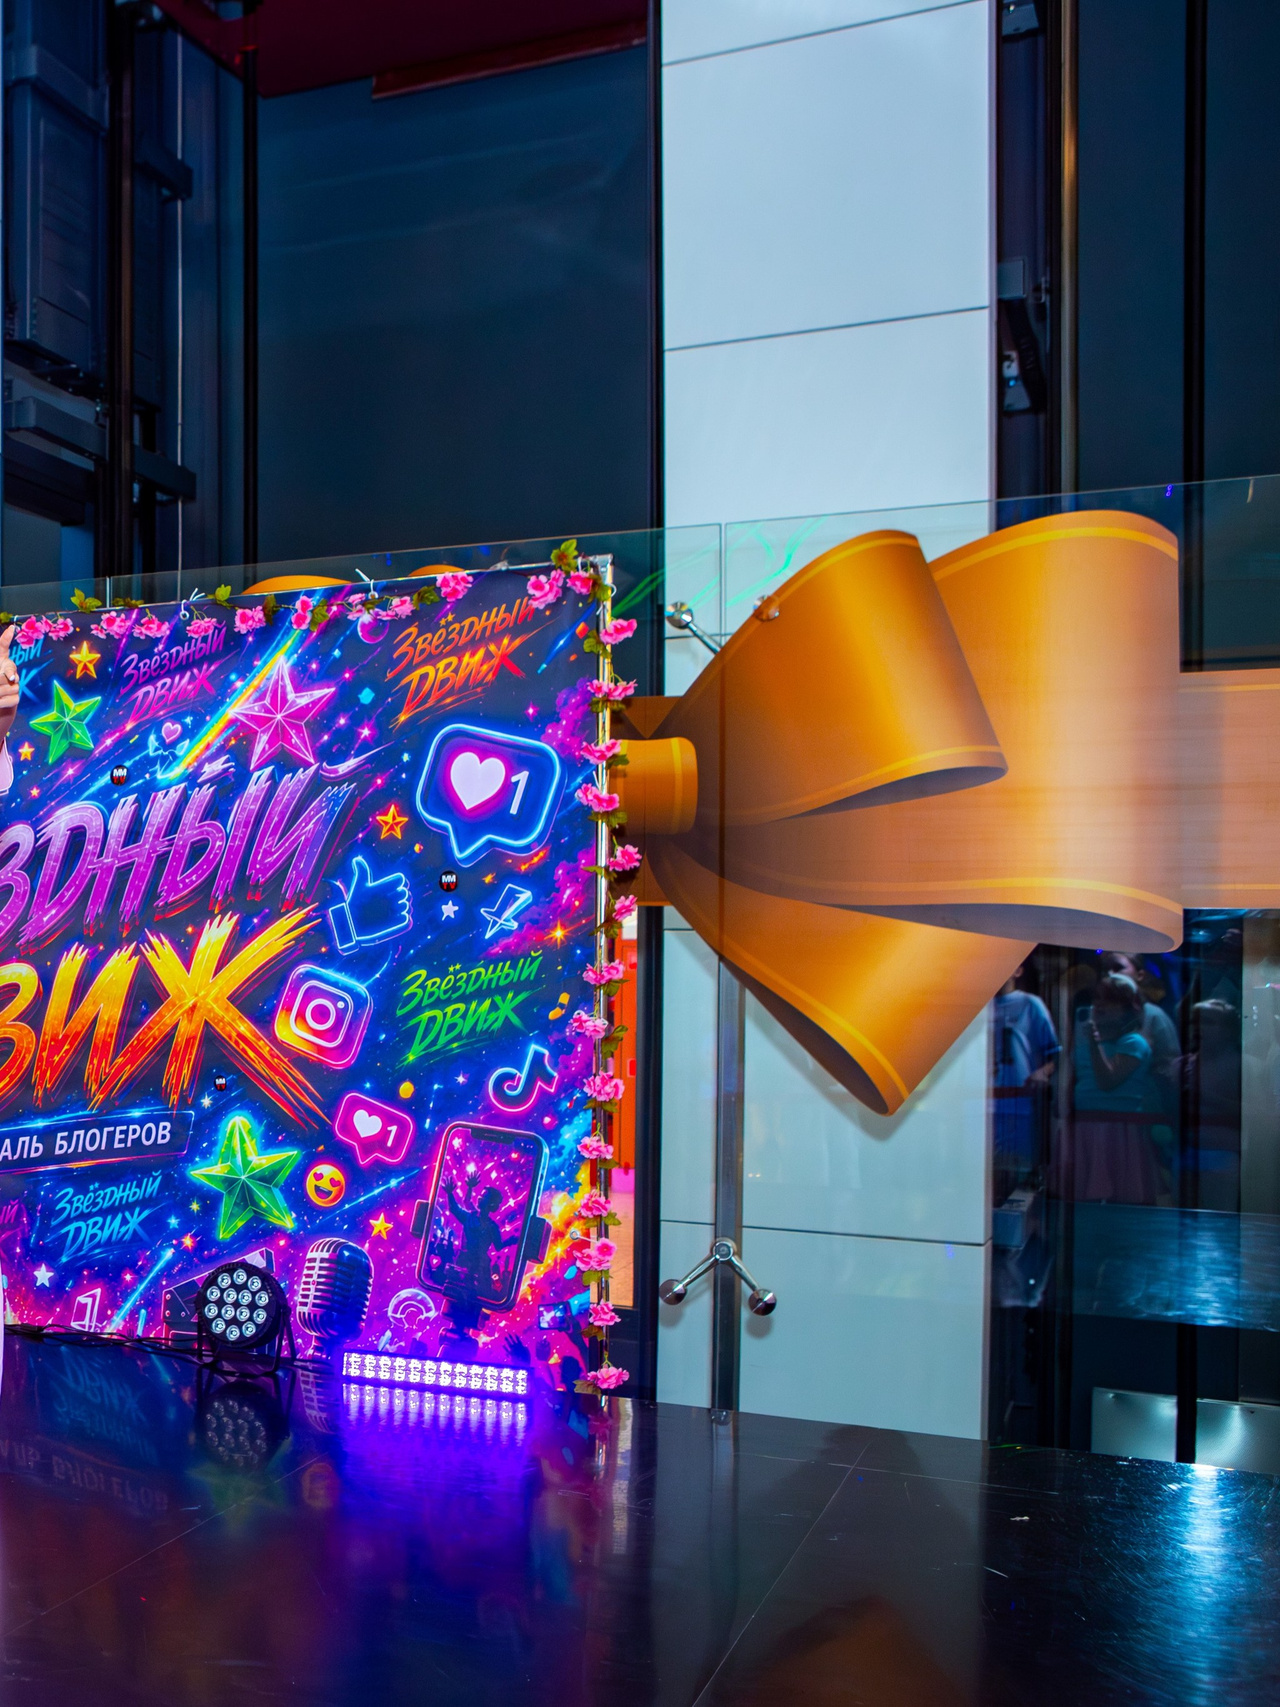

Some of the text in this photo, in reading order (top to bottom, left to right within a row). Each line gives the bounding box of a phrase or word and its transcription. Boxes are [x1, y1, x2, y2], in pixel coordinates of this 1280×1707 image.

[510, 770, 530, 815] 1
[54, 1121, 172, 1156] БЛОГЕРОВ
[385, 1125, 398, 1147] 1
